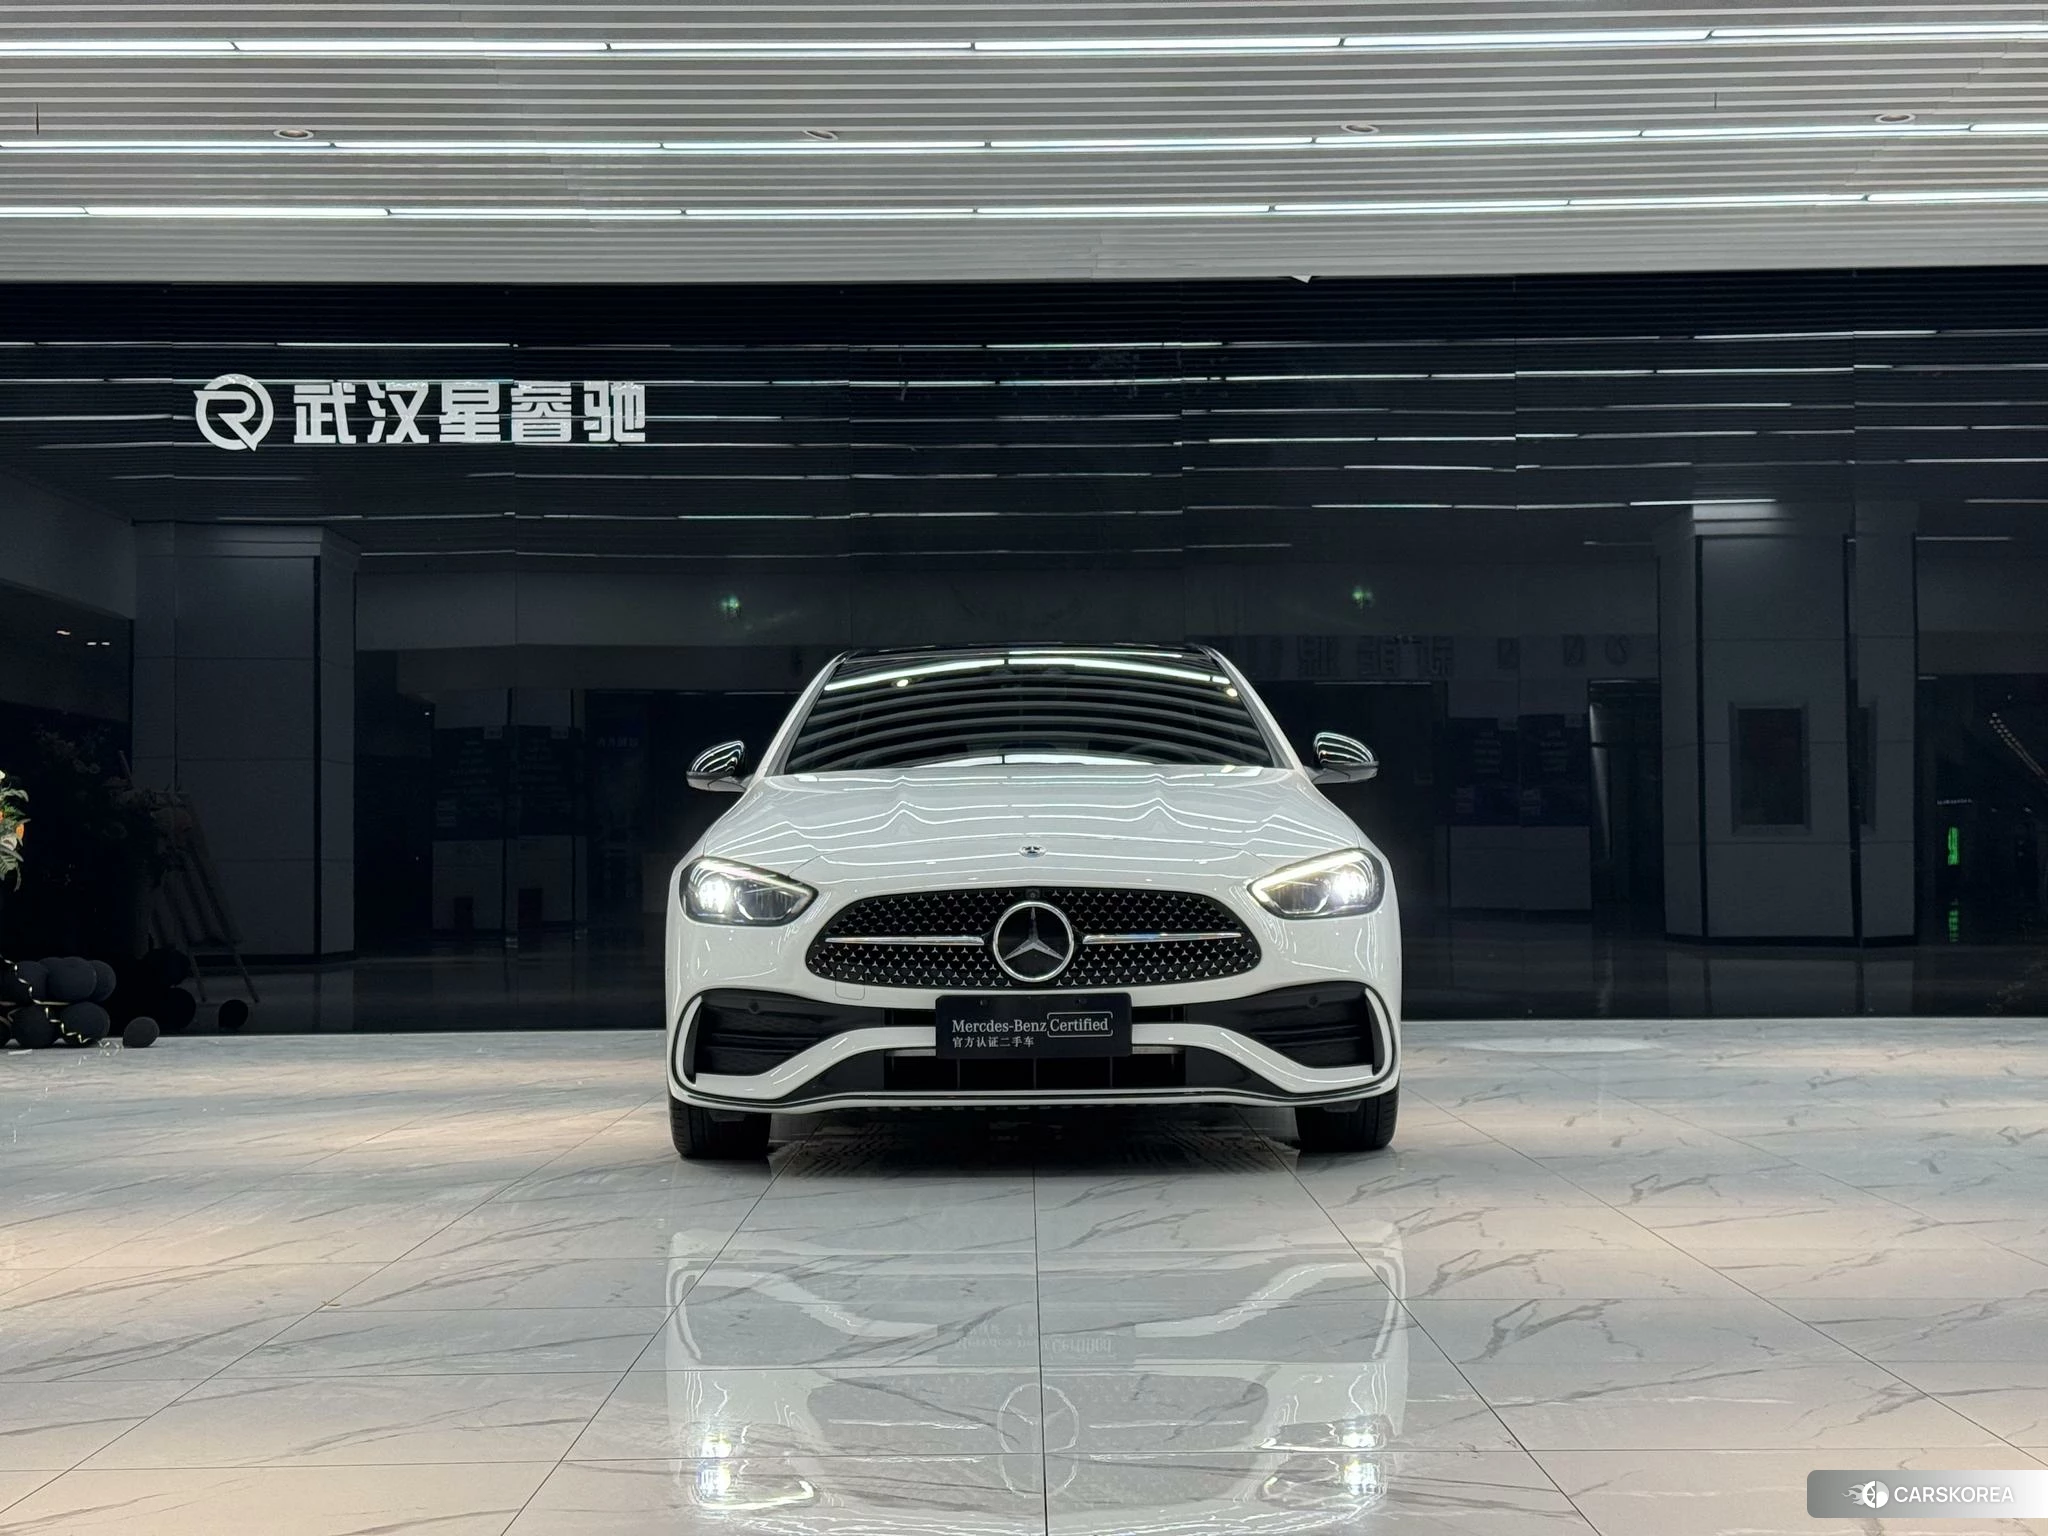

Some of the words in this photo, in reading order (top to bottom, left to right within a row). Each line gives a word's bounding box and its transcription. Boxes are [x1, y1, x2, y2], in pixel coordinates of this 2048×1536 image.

[293, 381, 647, 444] 武汉星睿驰
[1050, 1018, 1109, 1032] Certified
[952, 1036, 1035, 1049] 官方认证二手车
